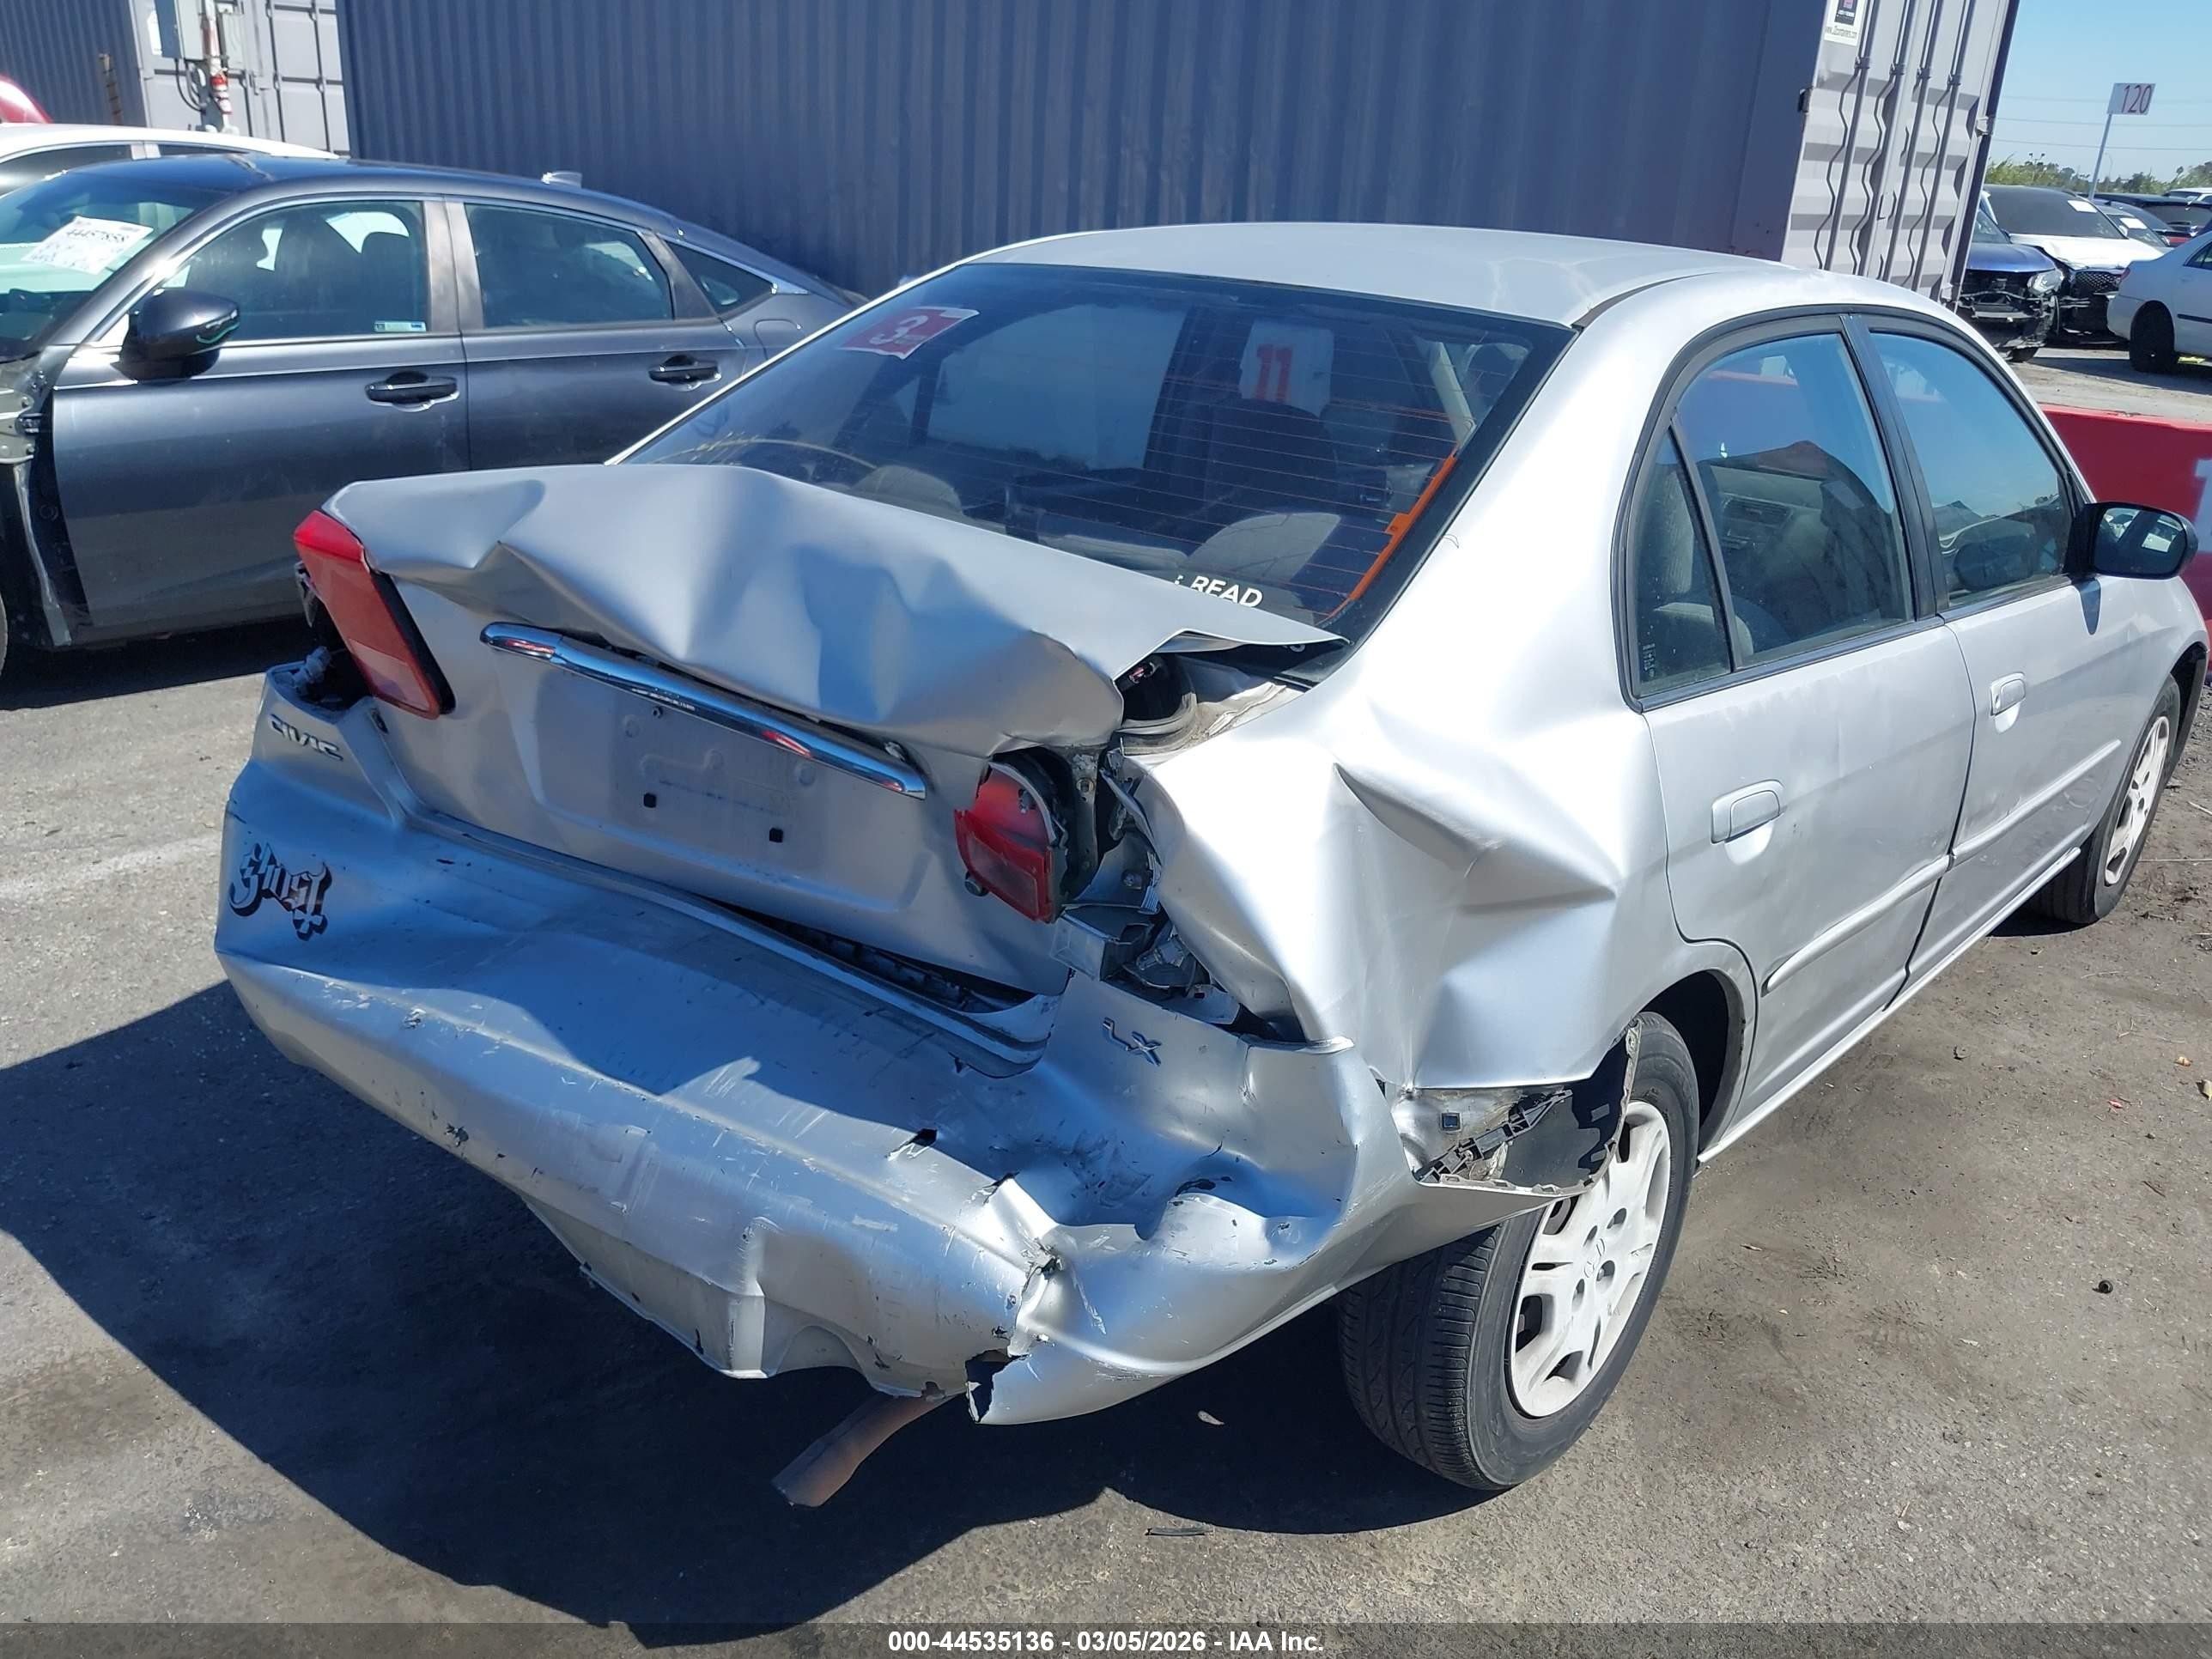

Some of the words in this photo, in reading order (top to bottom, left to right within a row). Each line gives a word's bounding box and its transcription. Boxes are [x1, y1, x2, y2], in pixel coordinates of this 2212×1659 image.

[2121, 84, 2153, 114] 120
[1190, 575, 1263, 607] READ
[270, 714, 344, 761] CIVIC
[1102, 1017, 1163, 1066] LX
